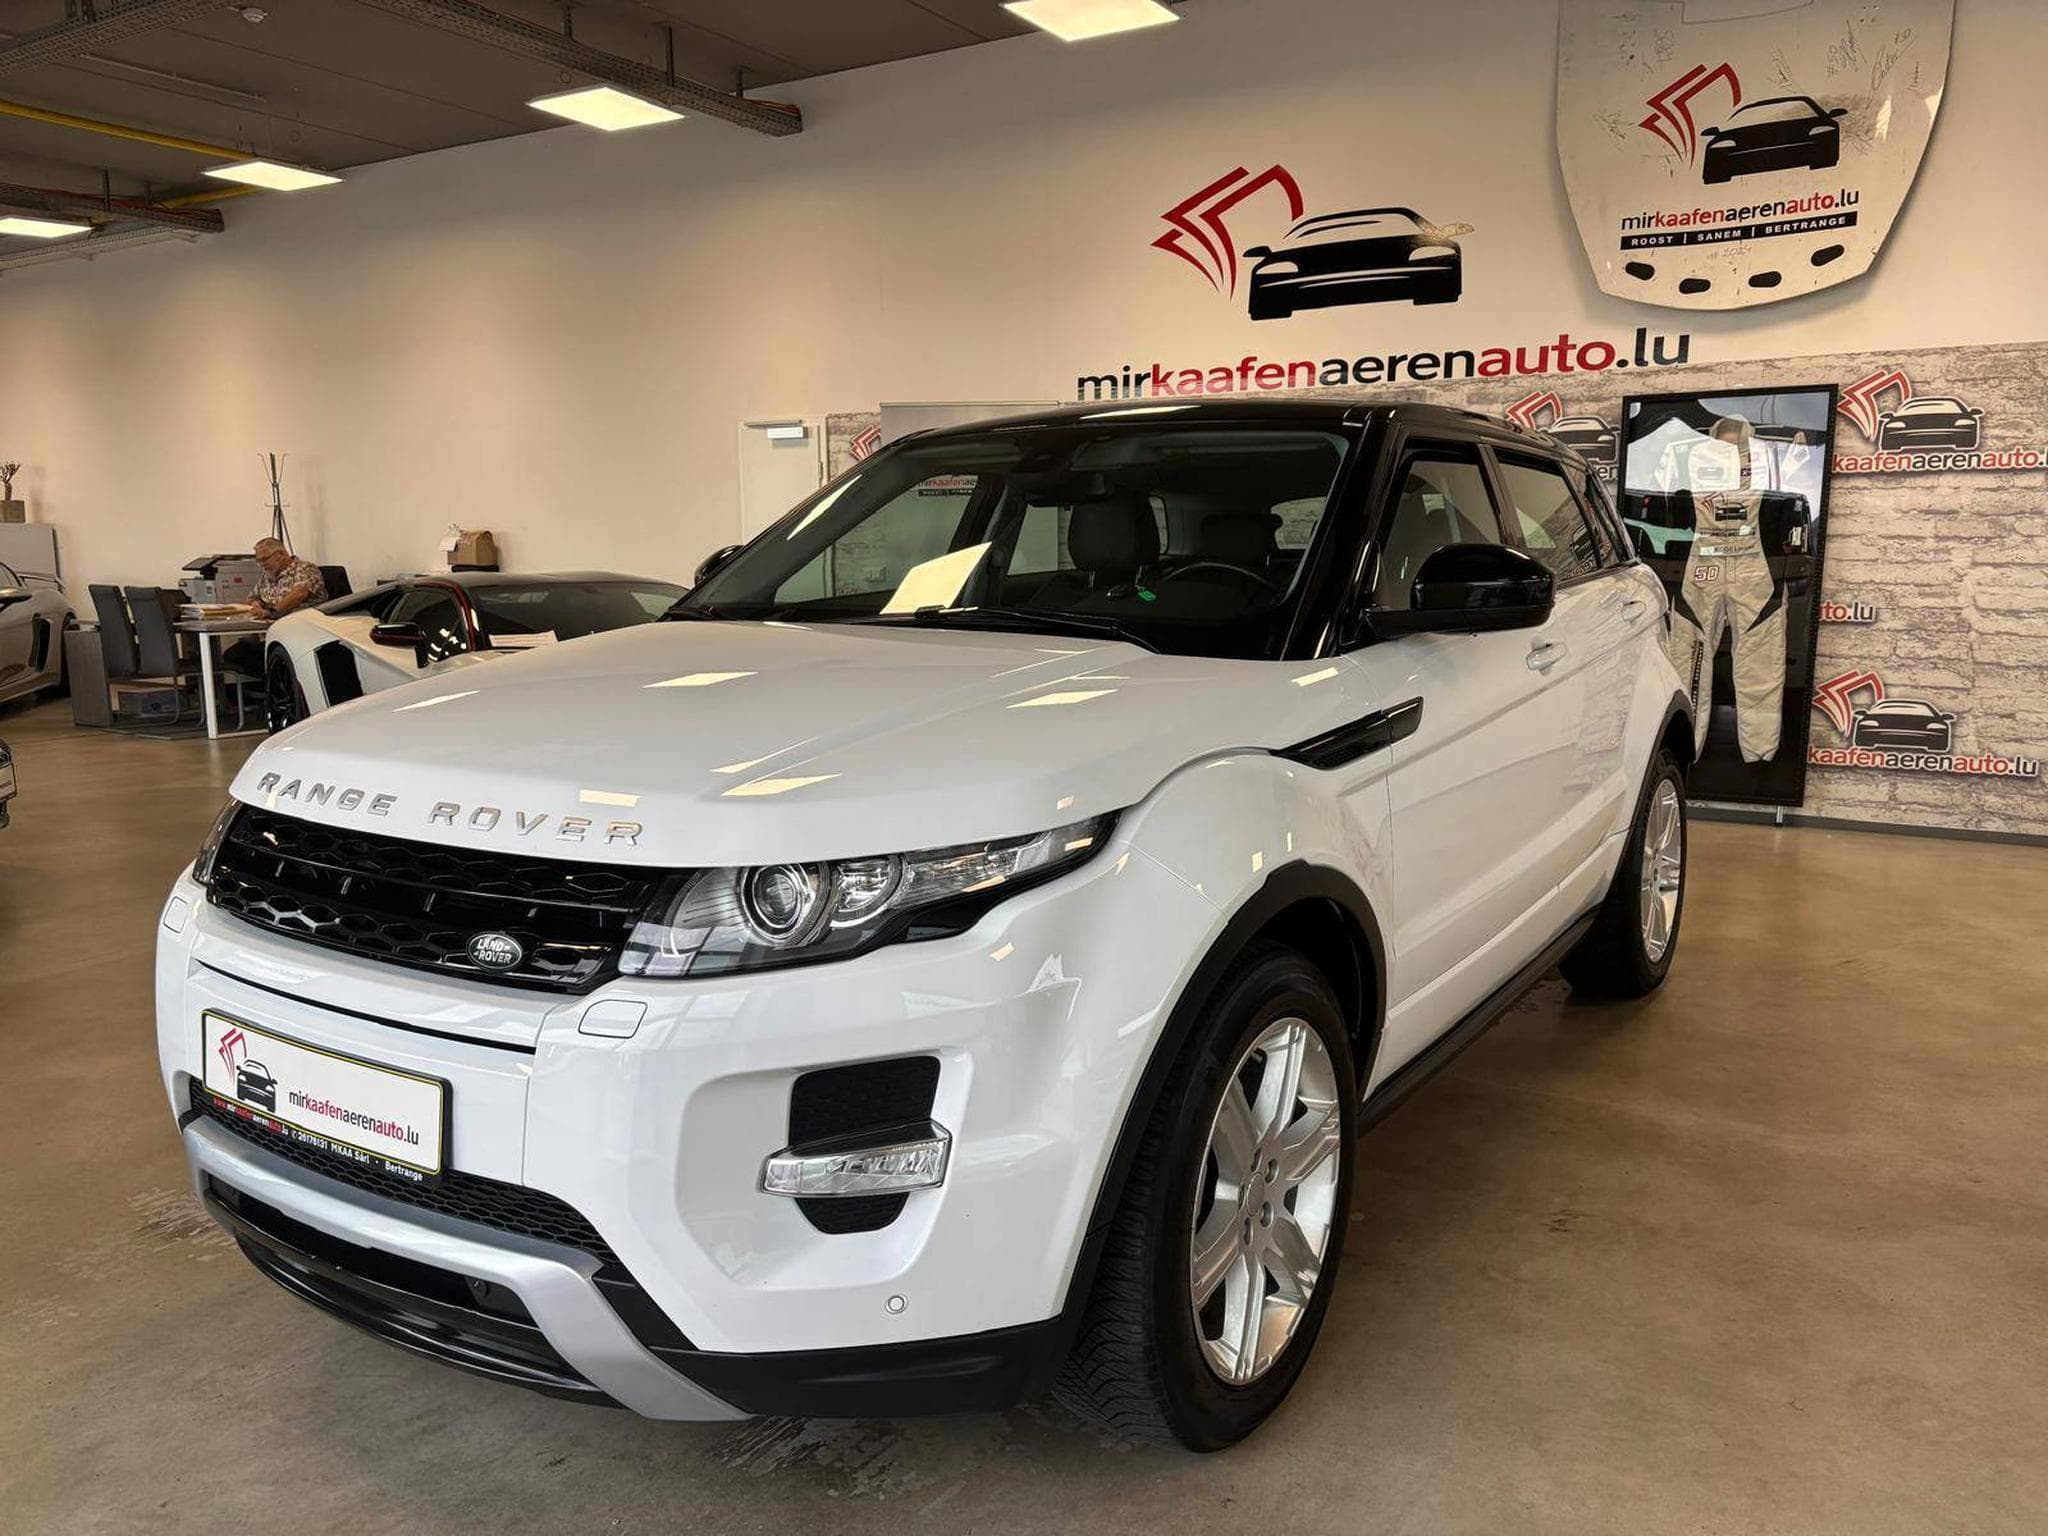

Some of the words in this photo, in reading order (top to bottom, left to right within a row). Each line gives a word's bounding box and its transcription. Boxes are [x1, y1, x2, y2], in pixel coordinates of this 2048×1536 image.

[1621, 189, 1859, 230] mirkaafenaerenauto.lu
[1631, 235, 1674, 246] ROOST
[1697, 230, 1742, 241] SANEM
[1765, 216, 1846, 234] BERTRANGE
[1077, 328, 1690, 400] mirkaafenaerenauto.lu
[1695, 565, 1719, 581] 50
[256, 772, 398, 817] RANGE
[426, 801, 643, 847] ROVER
[477, 939, 504, 951] LAND
[479, 950, 512, 963] ROVER
[289, 1091, 419, 1145] mirkaafenaerenauto.lu
